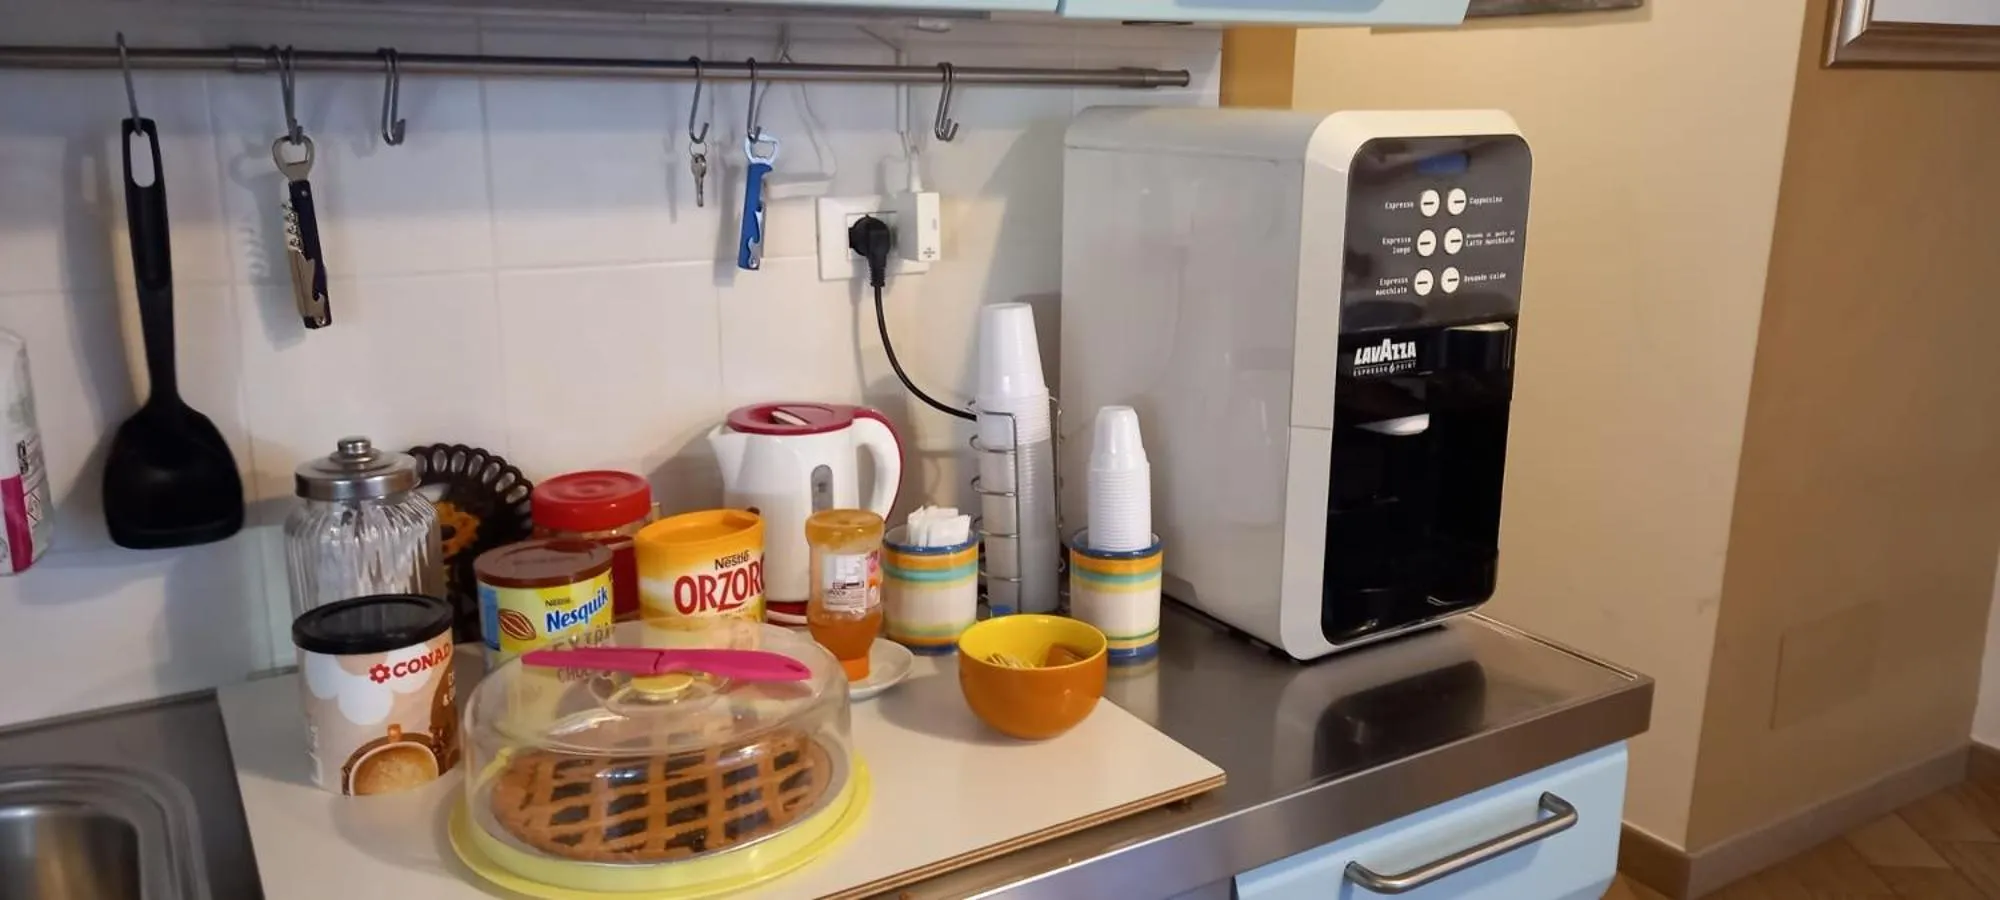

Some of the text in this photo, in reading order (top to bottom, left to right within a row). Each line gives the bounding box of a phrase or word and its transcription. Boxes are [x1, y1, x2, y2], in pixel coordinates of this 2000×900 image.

[1354, 338, 1416, 366] LAVAZZA
[674, 552, 765, 616] ORZOR
[546, 586, 609, 633] Nesquik
[393, 642, 450, 678] CONAD
